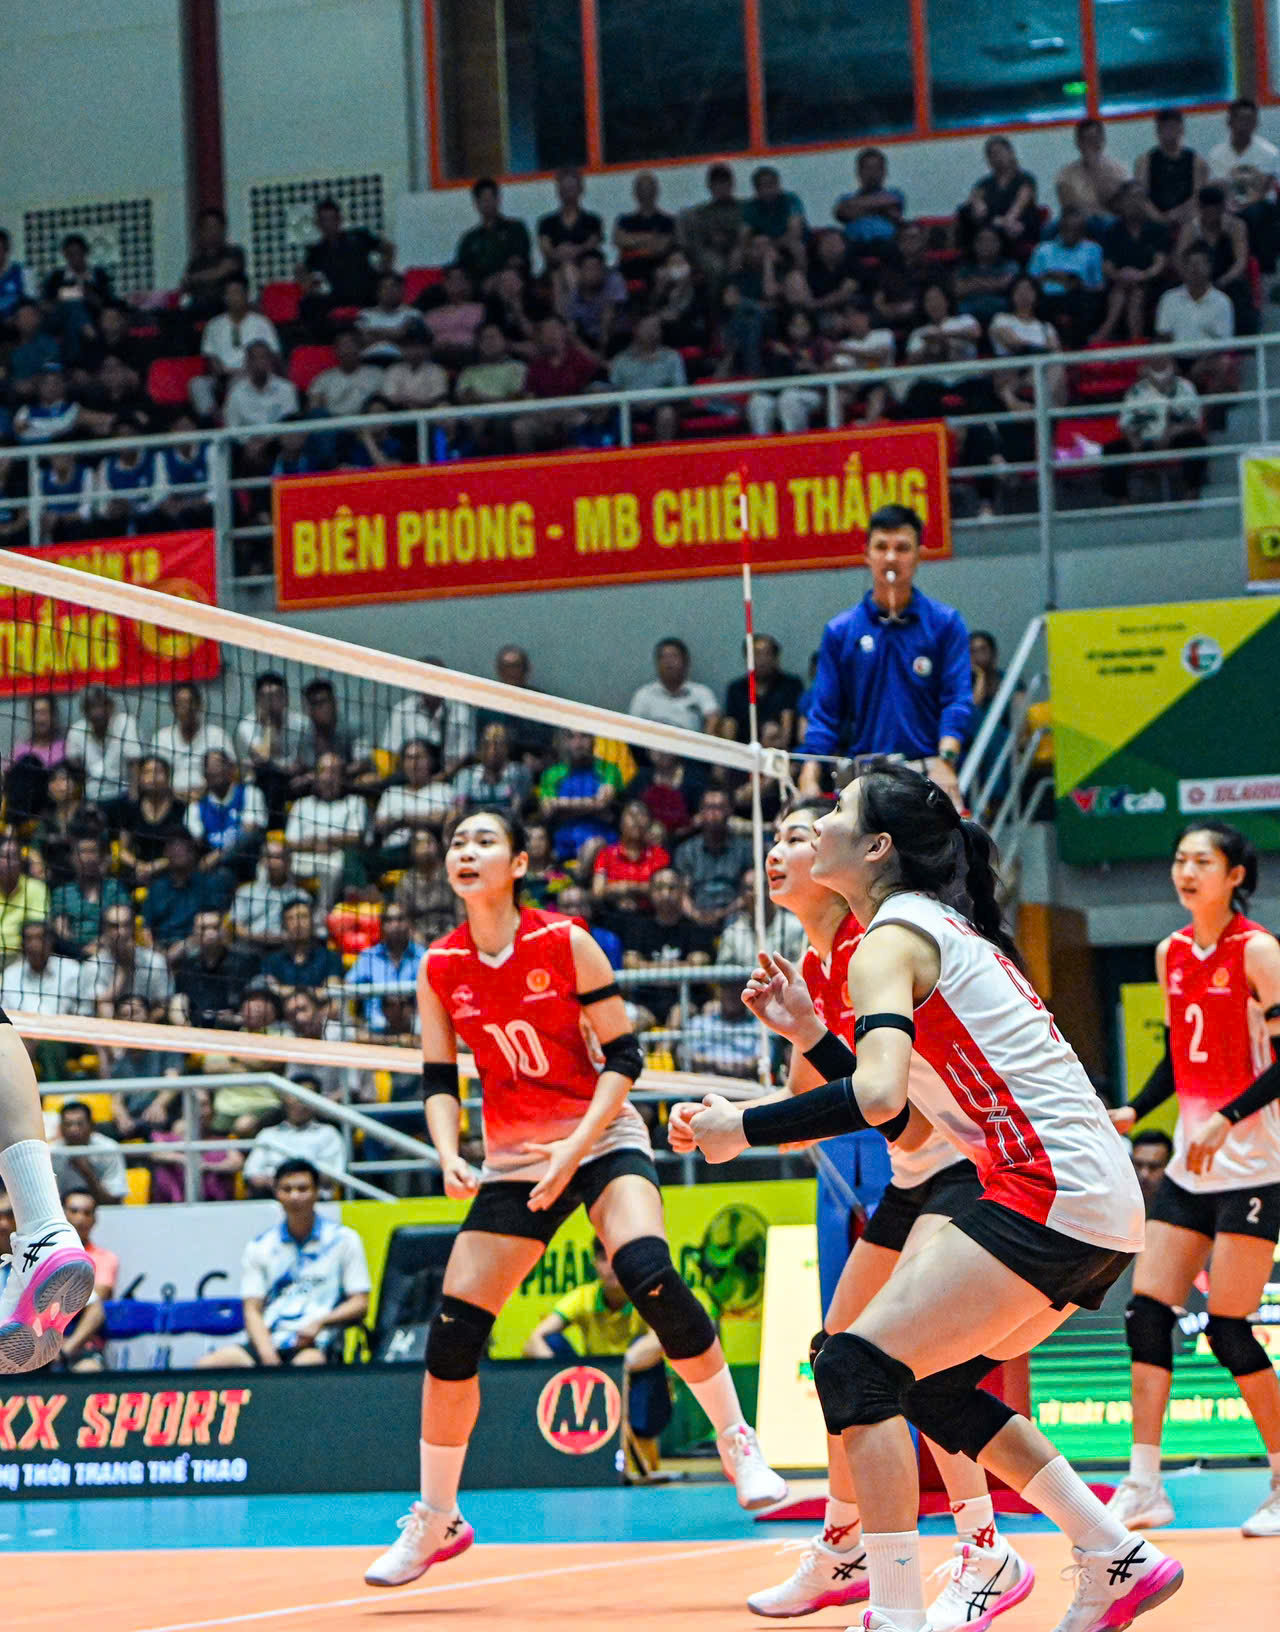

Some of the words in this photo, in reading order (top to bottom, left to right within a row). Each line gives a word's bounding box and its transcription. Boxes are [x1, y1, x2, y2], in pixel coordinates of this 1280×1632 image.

[293, 505, 386, 576] BIÊN
[397, 493, 535, 568] PHÒNG
[575, 493, 641, 553] MB
[483, 1020, 550, 1081] 10
[1185, 1003, 1208, 1063] 2
[1246, 1197, 1262, 1224] 2
[77, 1389, 252, 1448] SPORT
